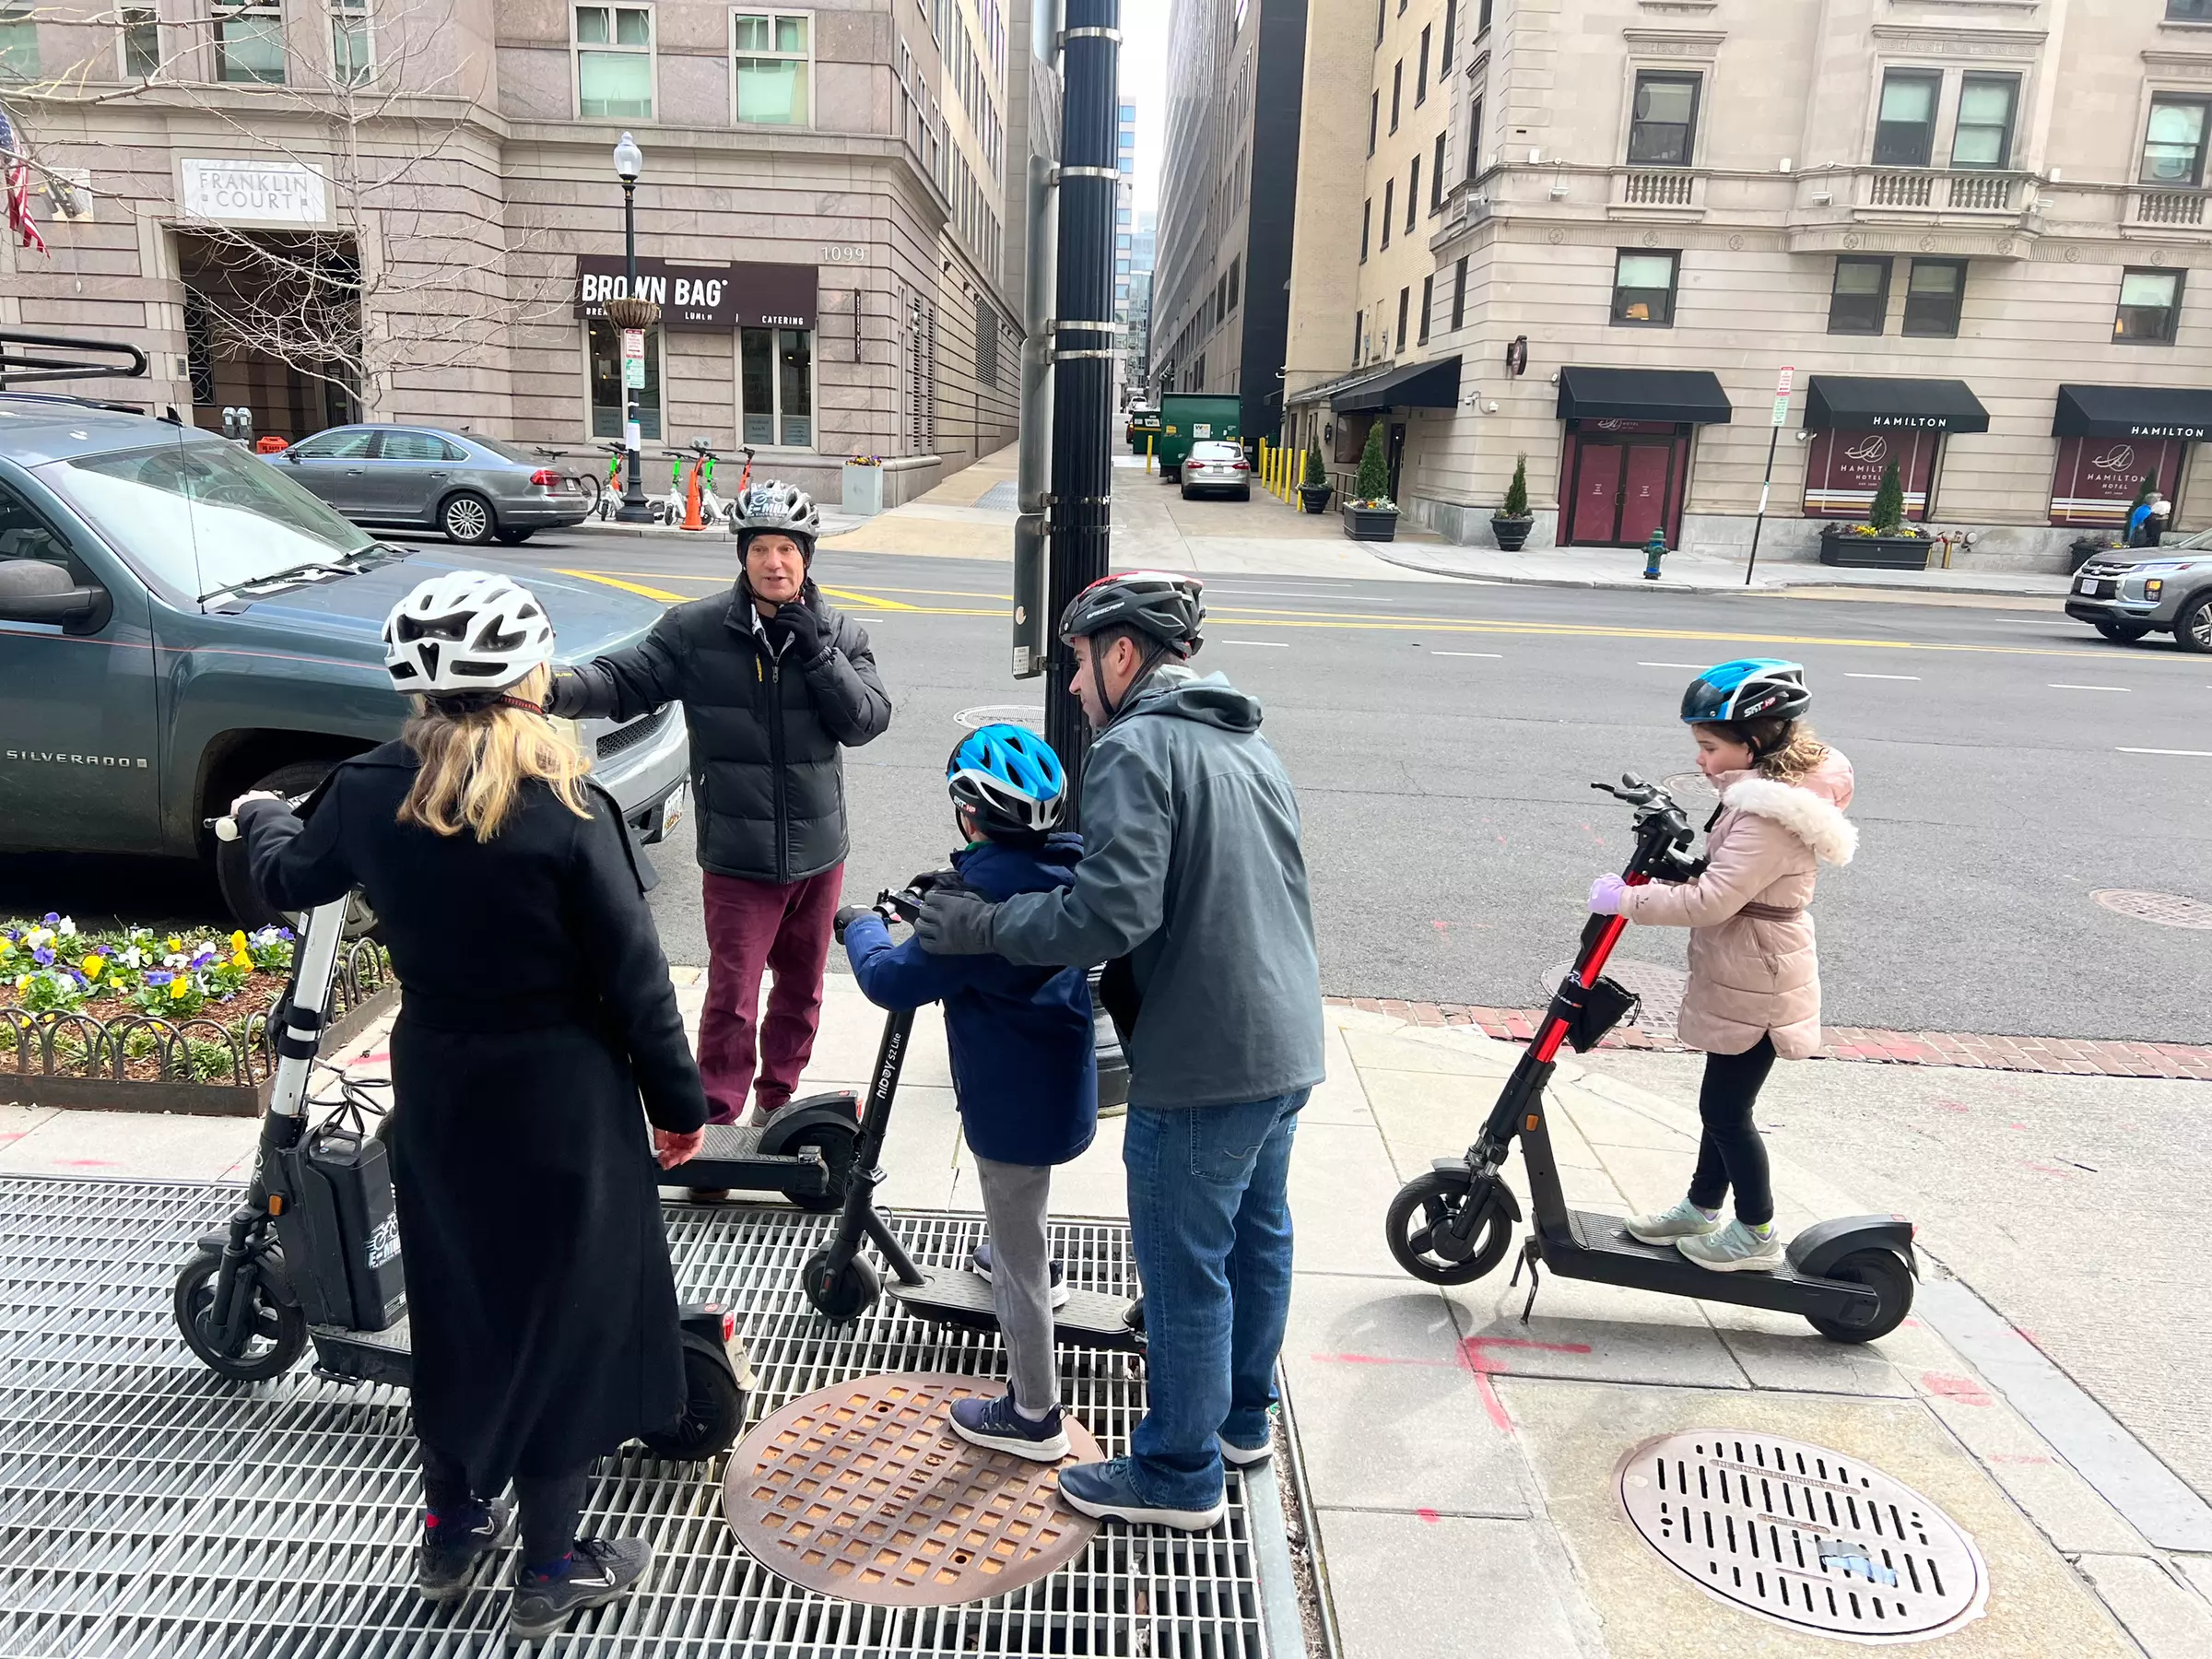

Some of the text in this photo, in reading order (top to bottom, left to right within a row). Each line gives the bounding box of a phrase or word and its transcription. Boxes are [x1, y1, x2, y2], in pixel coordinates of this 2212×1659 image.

[199, 172, 307, 192] FRANKLIN
[217, 191, 292, 208] COURT
[821, 246, 865, 262] 1099
[674, 278, 722, 307] BAG
[762, 315, 804, 325] CATERING
[1873, 417, 1947, 427] HAMILTON
[2131, 426, 2204, 437] HAMILTON
[1841, 465, 1900, 473] HAMILT
[6, 749, 130, 767] SILVERADO
[890, 1032, 901, 1049] Lite
[888, 1049, 898, 1061] S2
